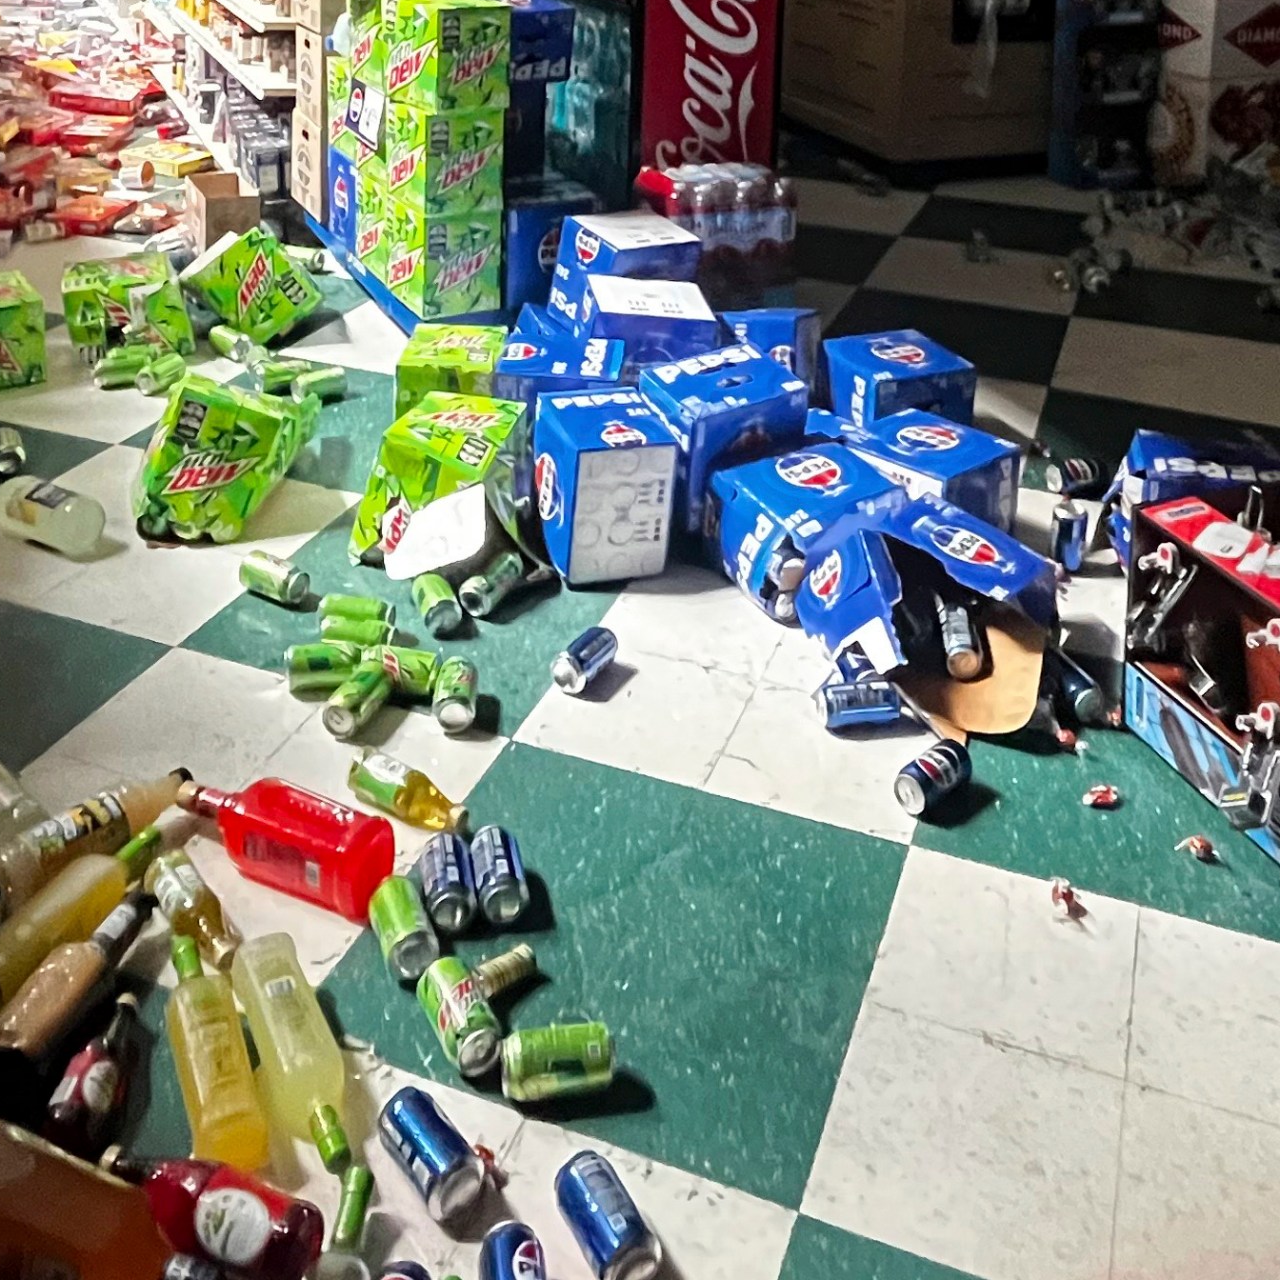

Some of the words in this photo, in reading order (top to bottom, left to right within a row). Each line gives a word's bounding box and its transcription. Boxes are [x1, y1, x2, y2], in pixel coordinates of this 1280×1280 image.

[652, 341, 763, 385] PEPSI
[551, 391, 643, 410] PEPSI
[851, 375, 867, 429] PEP
[784, 460, 831, 480] PEPSI
